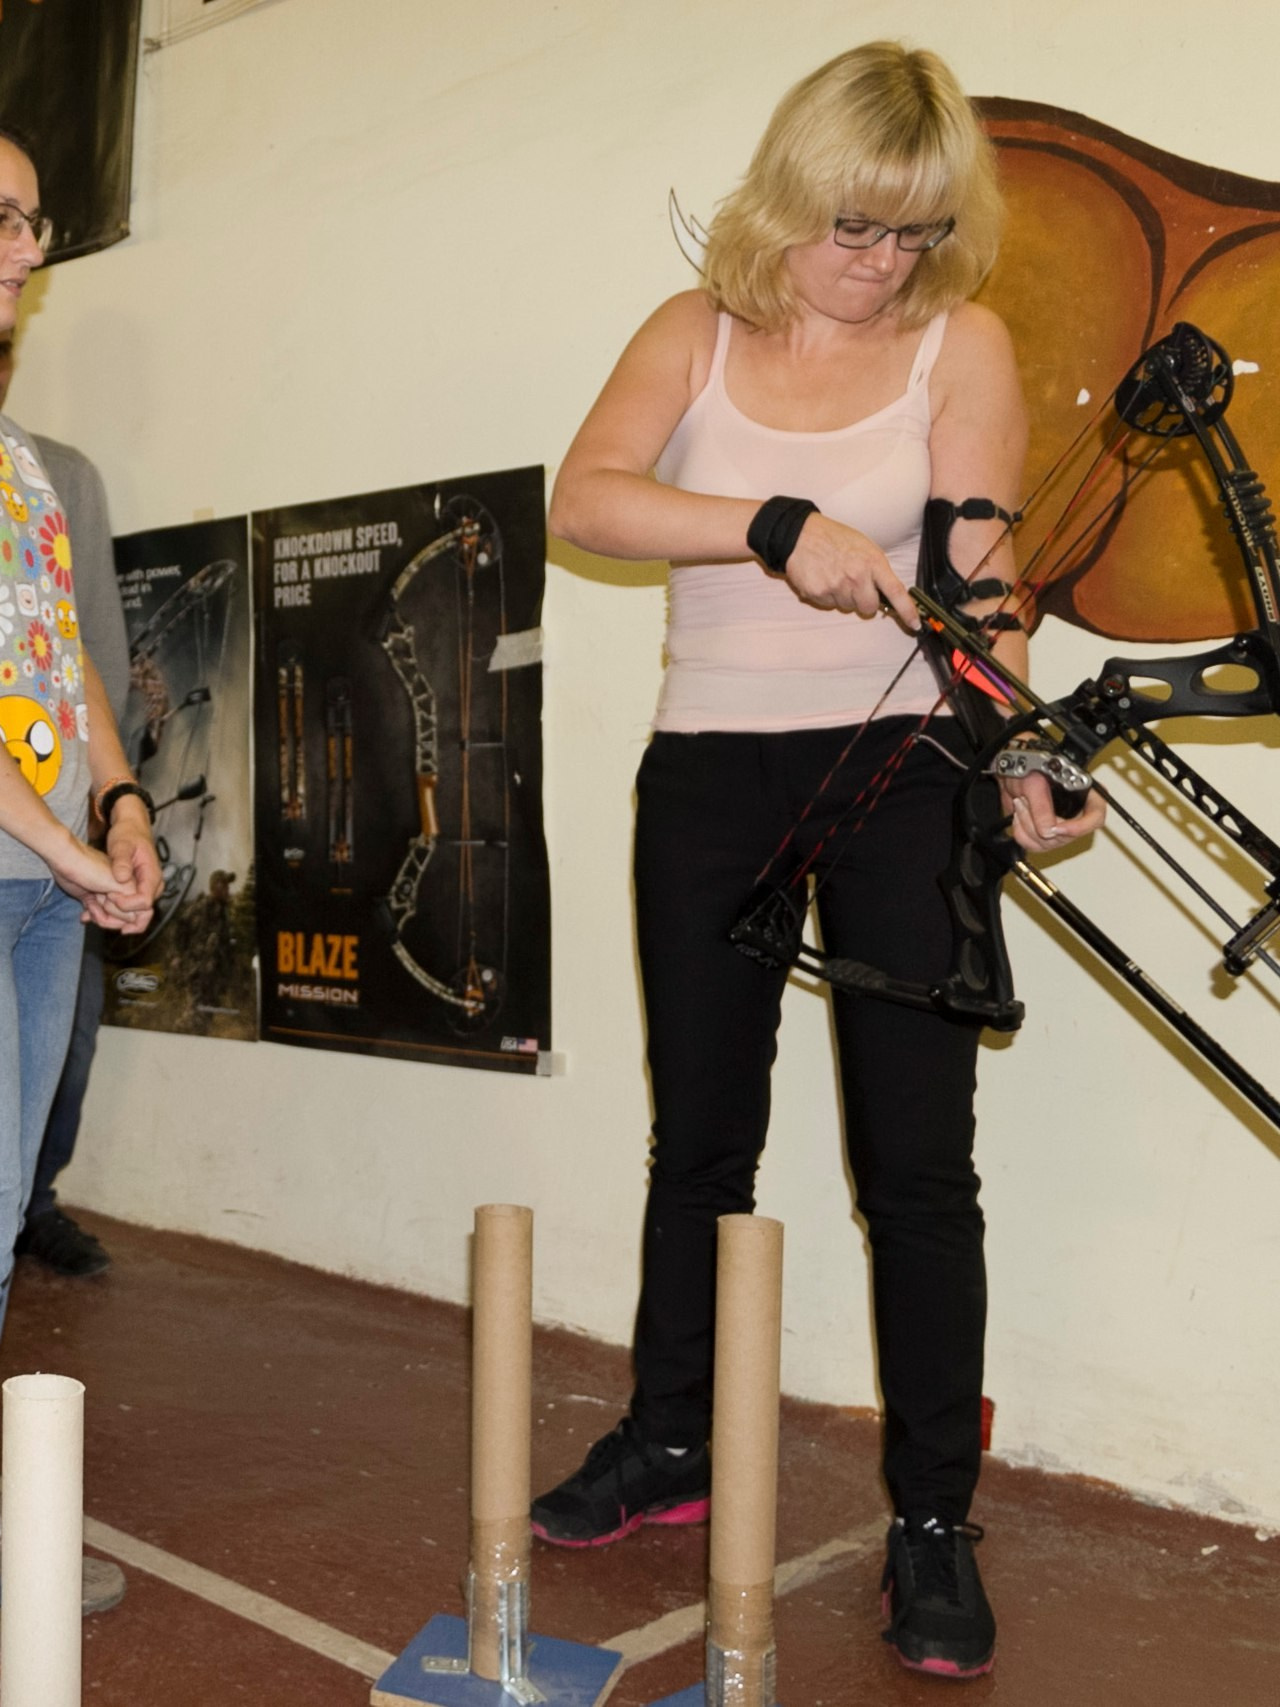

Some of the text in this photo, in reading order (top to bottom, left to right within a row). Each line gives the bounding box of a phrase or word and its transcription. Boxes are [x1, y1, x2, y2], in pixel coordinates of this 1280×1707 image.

[273, 521, 403, 560] KNOCKDOWN SPEED,
[273, 549, 381, 585] FOR A KNOCKOUT
[273, 583, 312, 608] PRICE
[277, 931, 359, 979] BLAZE
[277, 983, 359, 1003] MISSION
